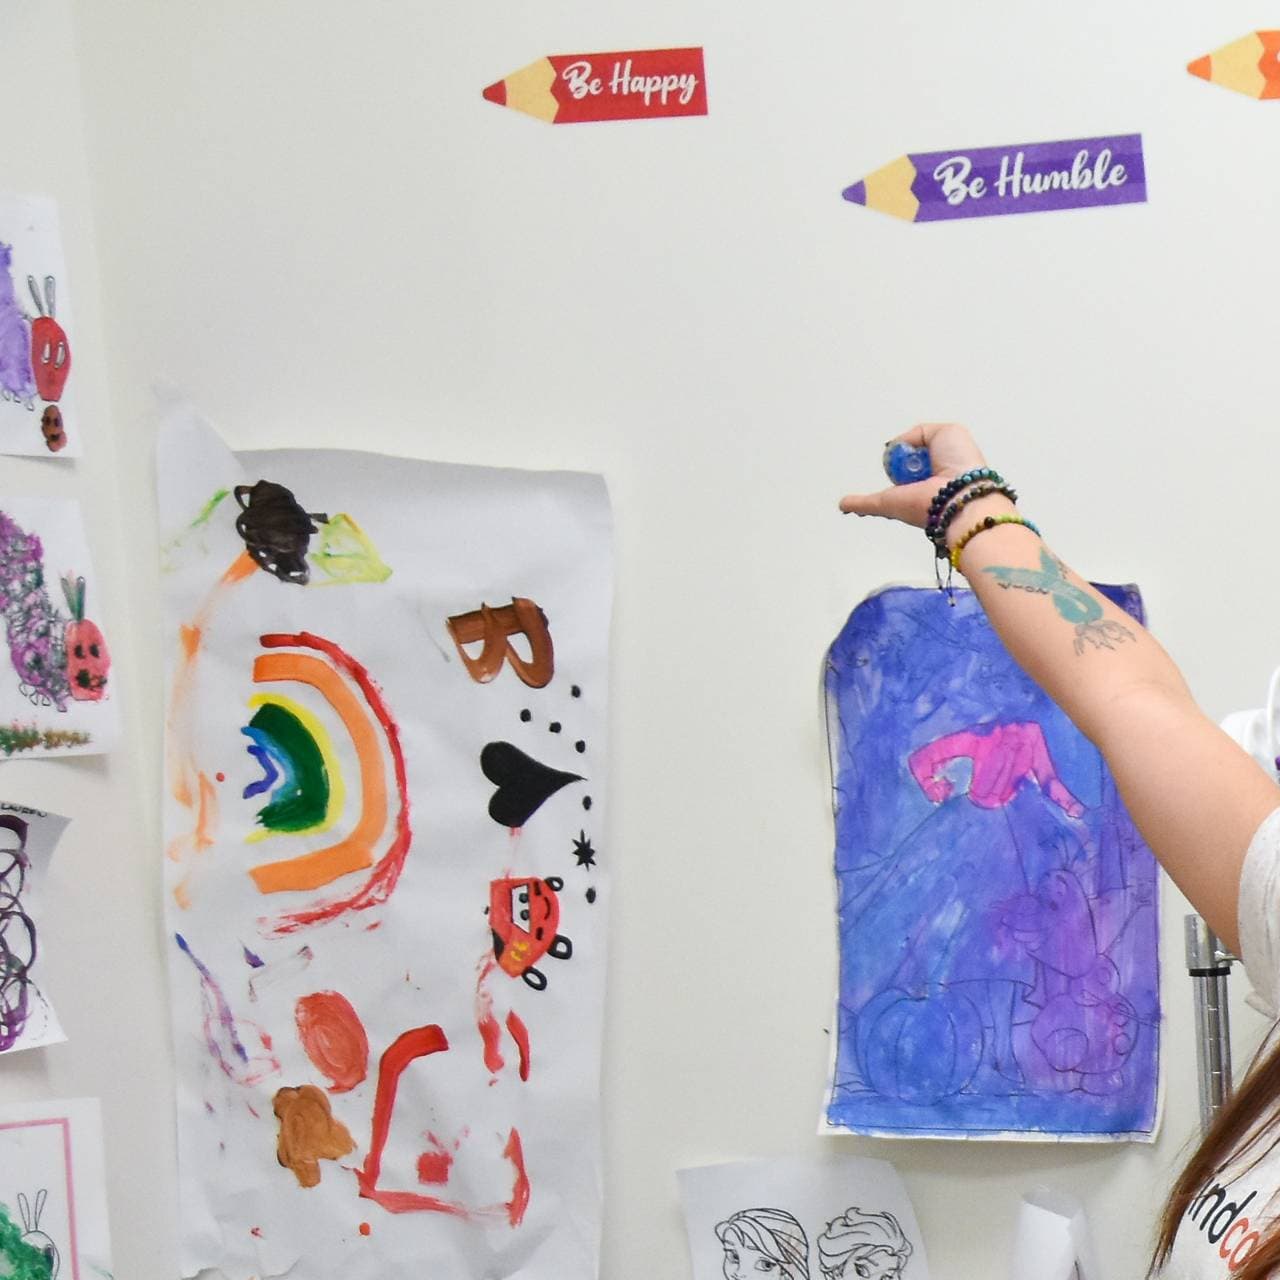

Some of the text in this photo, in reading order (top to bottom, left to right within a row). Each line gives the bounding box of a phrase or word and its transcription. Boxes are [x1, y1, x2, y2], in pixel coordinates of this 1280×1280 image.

[562, 57, 700, 106] Be Happy
[933, 146, 1127, 206] Be Humble
